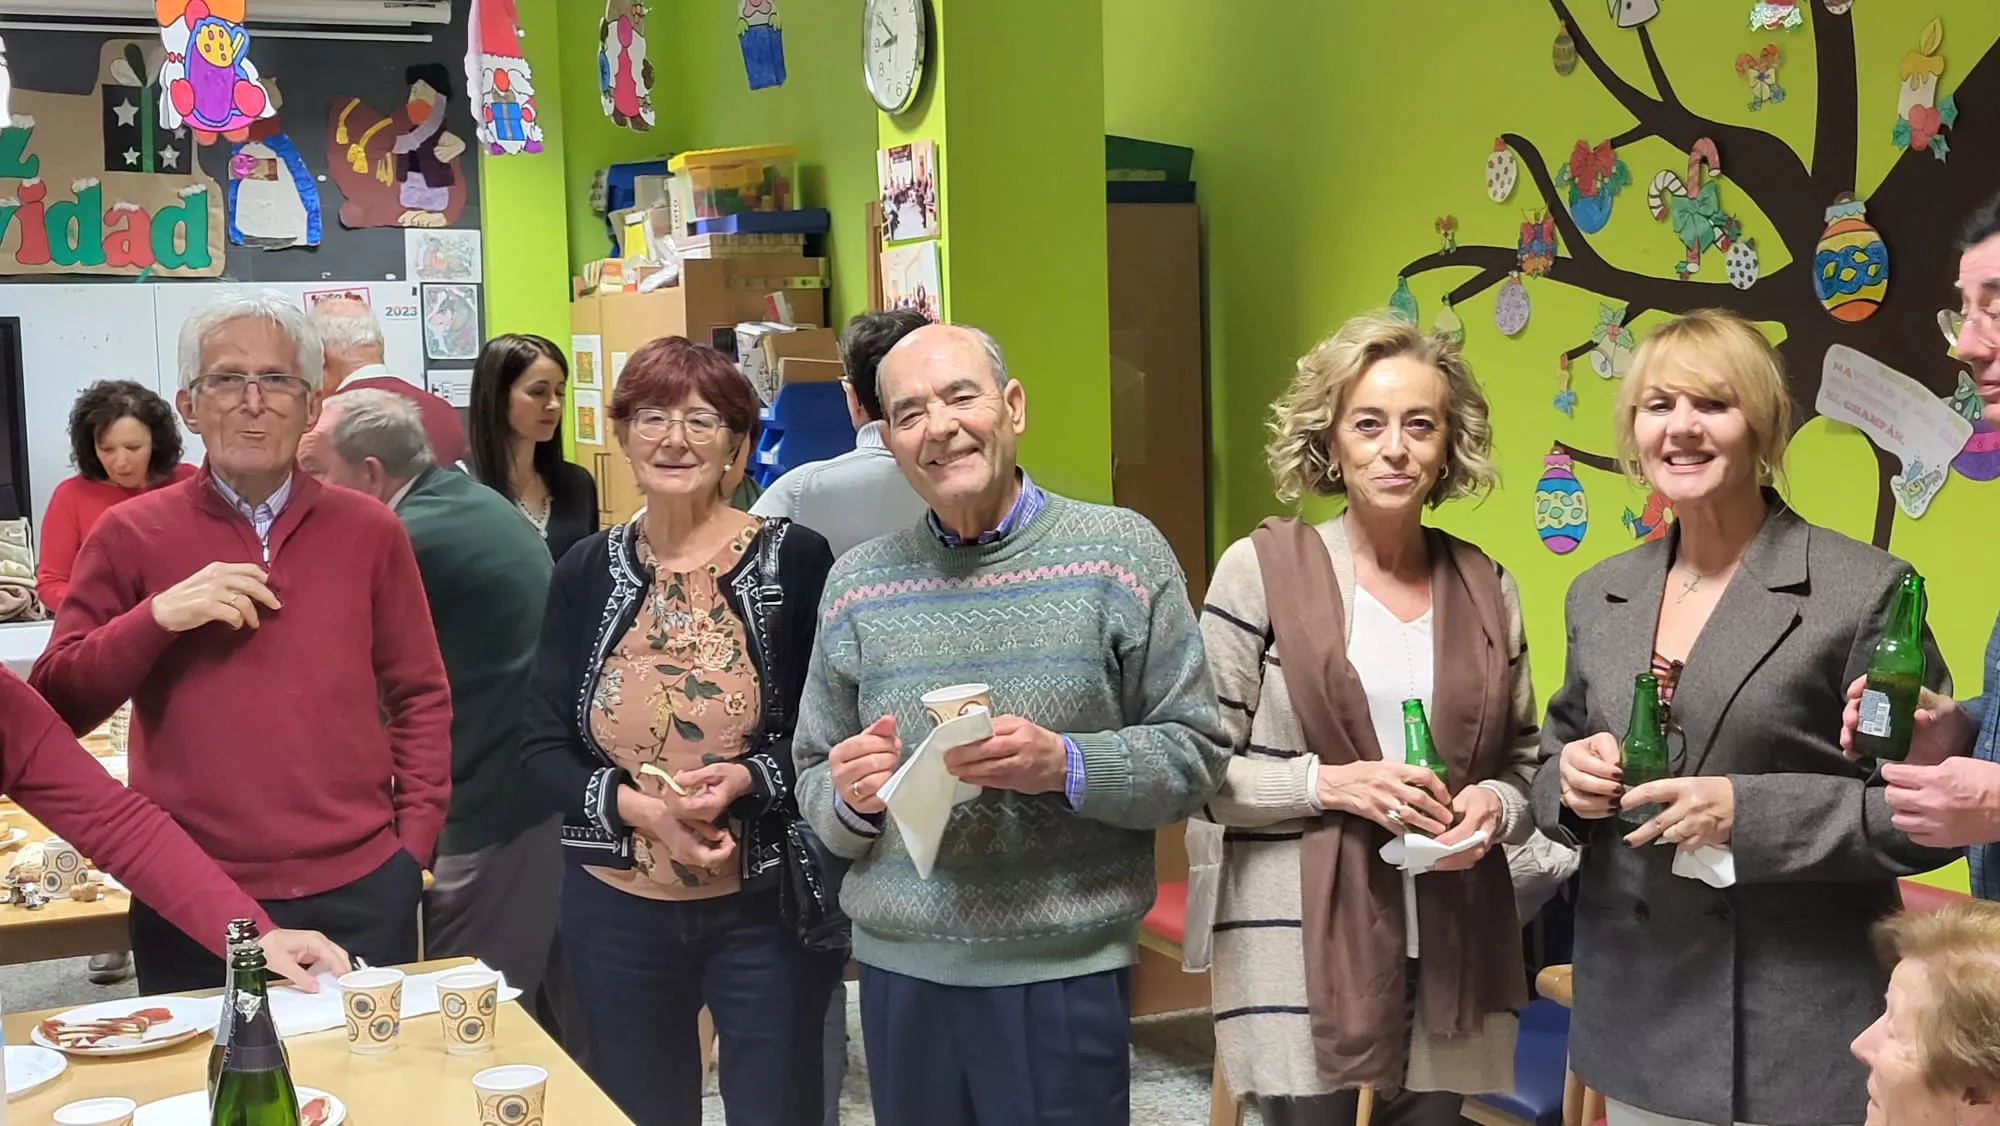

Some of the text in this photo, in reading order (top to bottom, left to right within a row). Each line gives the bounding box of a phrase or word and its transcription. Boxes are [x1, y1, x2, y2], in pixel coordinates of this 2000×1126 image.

[879, 62, 885, 77] 8
[886, 78, 892, 93] 7
[896, 82, 902, 97] 6
[385, 306, 417, 317] 2023
